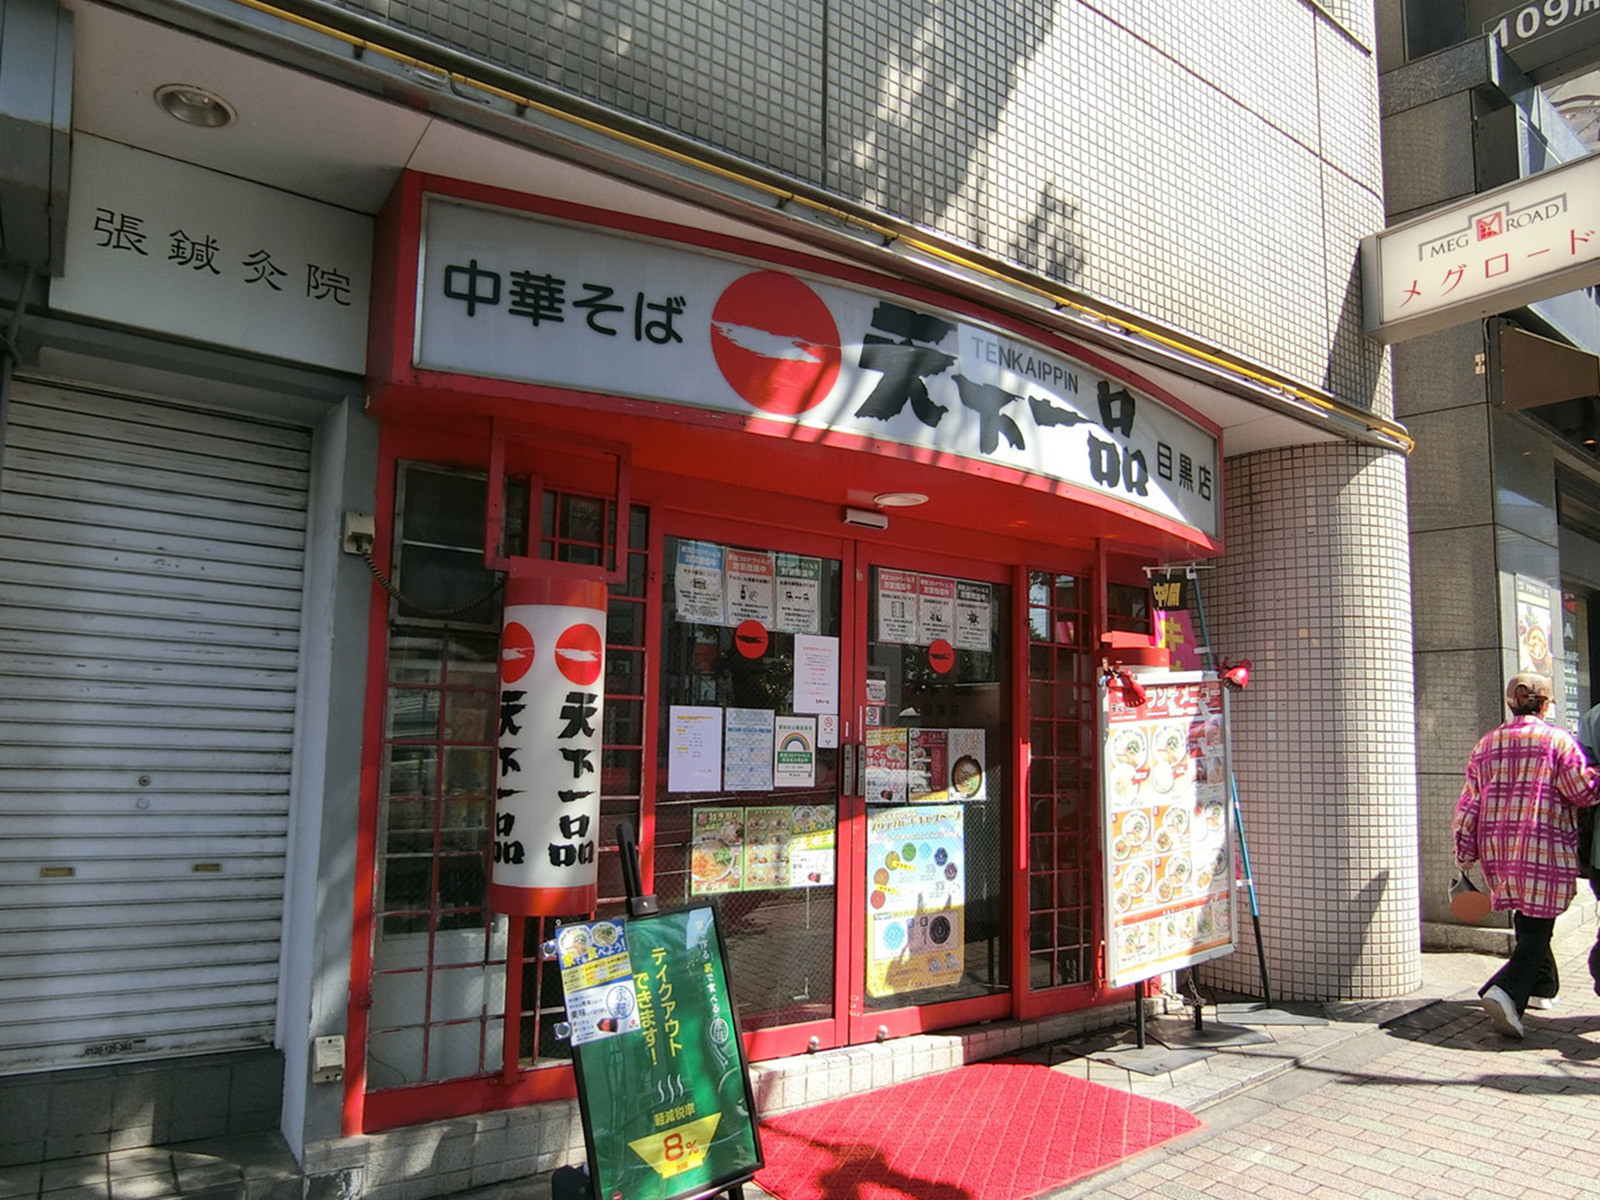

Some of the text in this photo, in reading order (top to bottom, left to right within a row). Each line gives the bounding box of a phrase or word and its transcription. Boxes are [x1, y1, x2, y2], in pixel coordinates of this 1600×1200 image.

[94, 208, 351, 306] 張鍼灸院
[1398, 229, 1596, 309] メグロード
[1430, 203, 1560, 258] MEG ROAD
[443, 258, 686, 344] 中華そば
[854, 300, 1149, 497] 天下一品
[970, 336, 1079, 394] TENKAIPPIN
[1157, 441, 1212, 501] 目黒店
[548, 691, 599, 867] 天下一品
[633, 972, 658, 1065] できます!
[652, 948, 683, 1057] テイクアウト
[654, 1102, 695, 1127] 軽減税率
